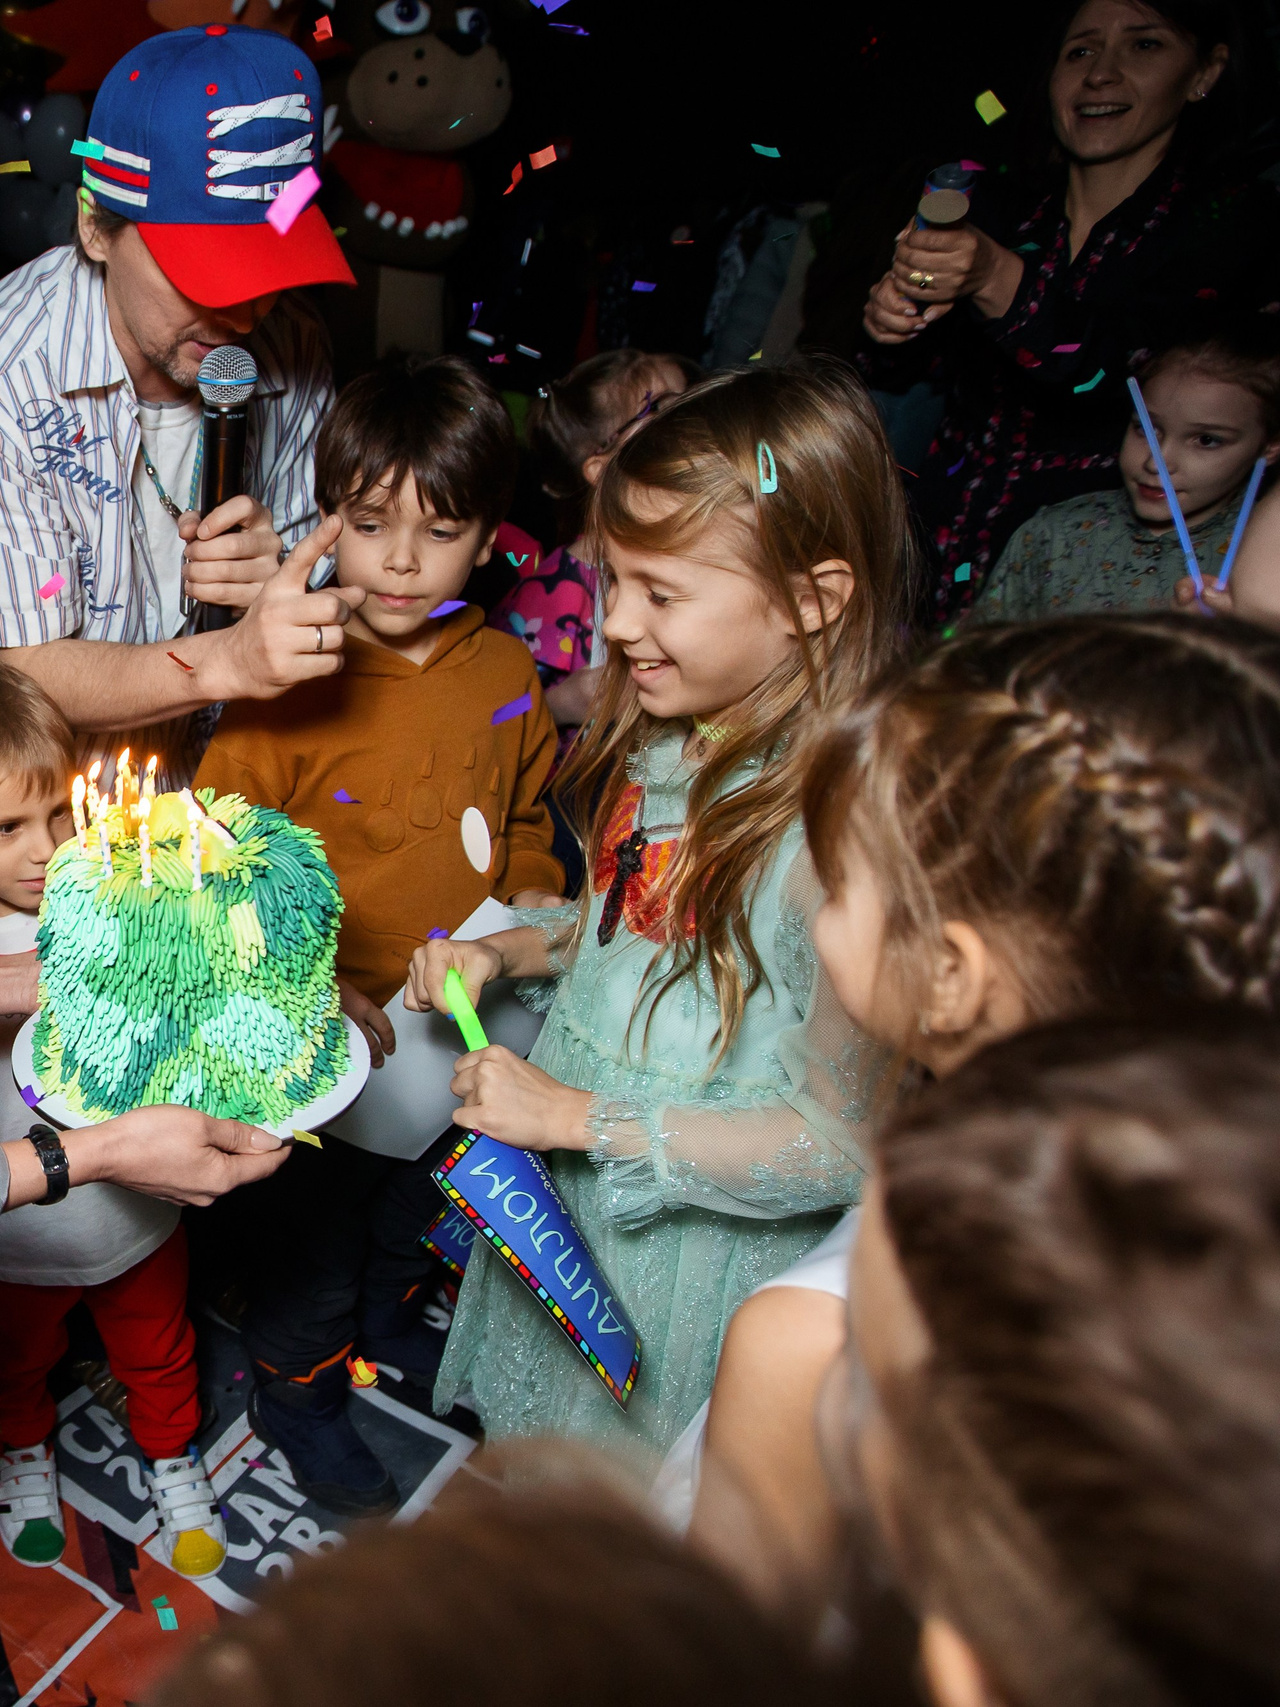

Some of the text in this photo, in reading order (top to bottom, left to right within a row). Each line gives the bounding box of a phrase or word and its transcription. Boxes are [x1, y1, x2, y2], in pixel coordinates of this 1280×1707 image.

[31, 444, 126, 503] Farm
[469, 1157, 627, 1336] ДИПЛОМ
[58, 1404, 128, 1465] CA
